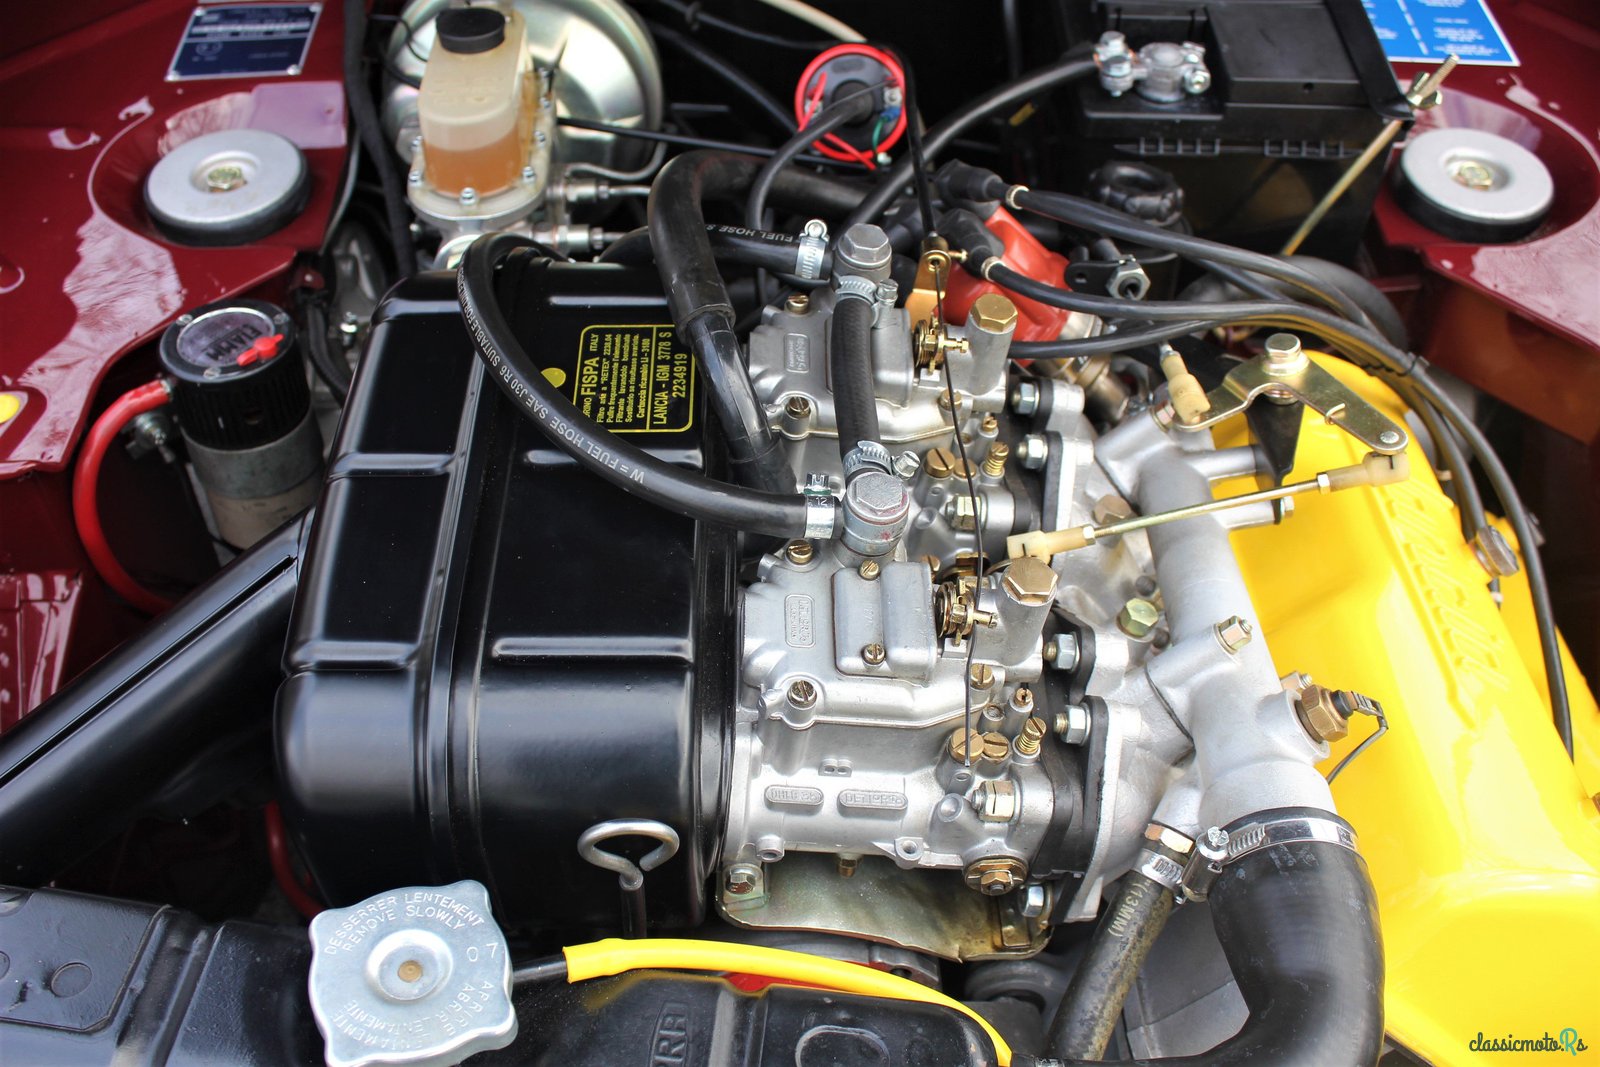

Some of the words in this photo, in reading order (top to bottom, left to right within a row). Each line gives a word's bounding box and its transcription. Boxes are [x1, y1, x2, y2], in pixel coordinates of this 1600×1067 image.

[719, 225, 756, 237] HOSE
[760, 231, 794, 242] FUEL
[204, 324, 263, 361] FIAMM
[471, 319, 501, 367] SUITABLE
[589, 333, 599, 352] ITALY
[657, 341, 672, 360] 3778
[499, 365, 513, 383] R6
[581, 356, 600, 396] FISPA
[656, 364, 670, 381] IGM
[672, 353, 688, 398] 2234919
[510, 378, 528, 398] J30
[525, 393, 549, 419] SAE
[582, 397, 592, 418] RINO
[653, 391, 668, 425] LANCIA
[549, 416, 585, 448] HOSE
[586, 441, 620, 470] FUEL
[629, 469, 646, 484] W
[324, 896, 398, 955] DESSERRER
[404, 892, 485, 927] LENTEMENT
[1107, 882, 1148, 938] (13MM)
[341, 908, 397, 952] REMOVE
[405, 905, 466, 931] SLOWLY
